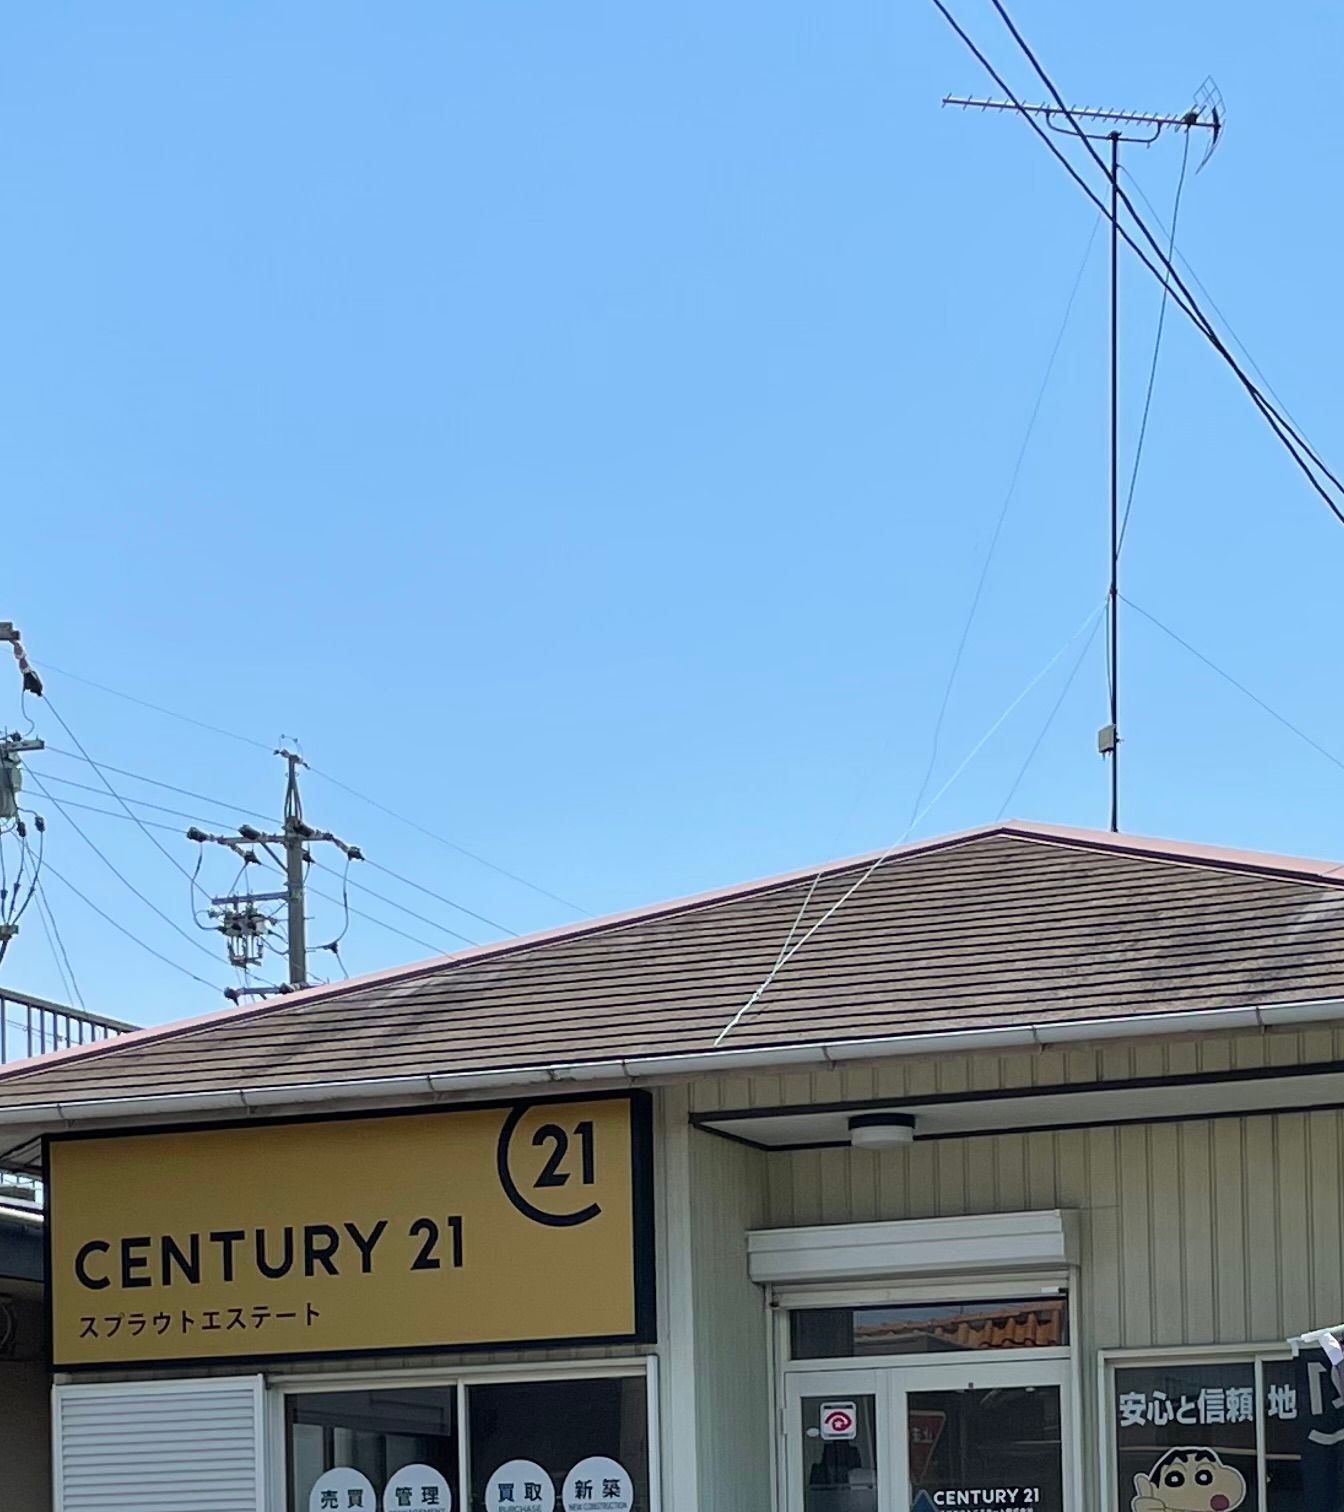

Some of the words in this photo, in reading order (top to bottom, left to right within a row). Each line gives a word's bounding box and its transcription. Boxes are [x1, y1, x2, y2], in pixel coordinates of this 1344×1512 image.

[74, 1220, 388, 1290] CENTURY
[408, 1215, 464, 1271] 21
[79, 1302, 321, 1338] スプラウトエステート
[1119, 1387, 1254, 1427] 安心と信頼
[1268, 1384, 1297, 1420] 地
[321, 1489, 363, 1509] 売買
[395, 1486, 440, 1506] 管理
[498, 1482, 542, 1502] 買取
[575, 1479, 621, 1500] 新築
[933, 1488, 1019, 1505] CENTURY
[1023, 1487, 1039, 1502] 21
[498, 1504, 542, 1512] PURCHASE
